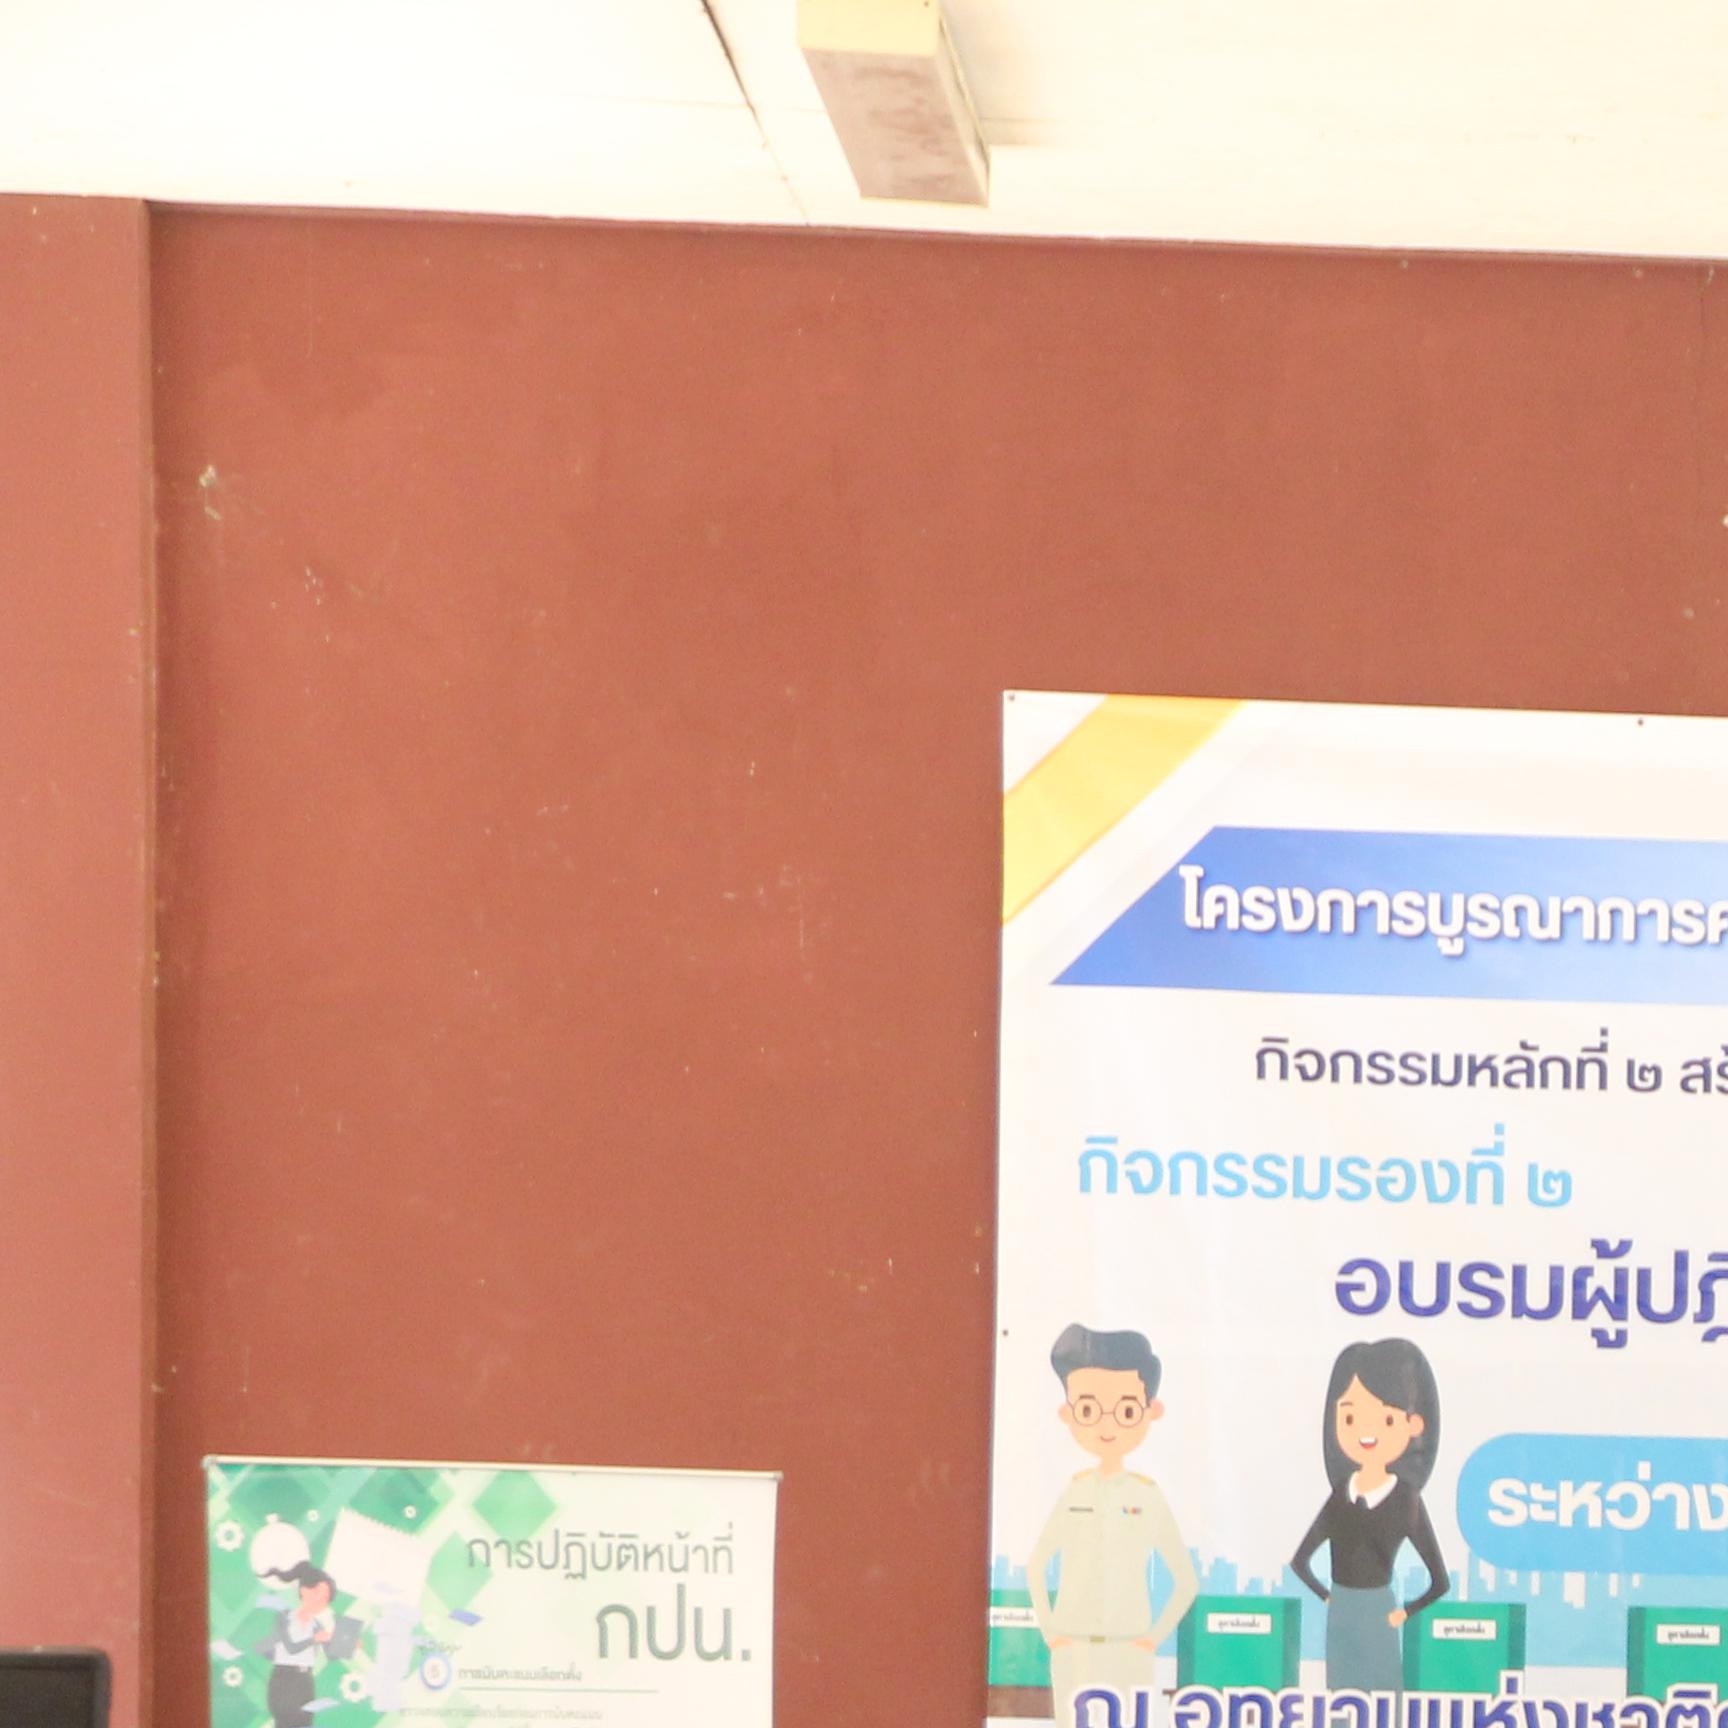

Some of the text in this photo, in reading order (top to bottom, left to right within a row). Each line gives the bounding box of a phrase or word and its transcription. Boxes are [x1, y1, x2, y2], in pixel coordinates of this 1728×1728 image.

[1254, 1029, 1609, 1092] กิจกรรมหลักที่
[1625, 1056, 1662, 1092] ๒
[1077, 1124, 1573, 1208] กิจกรรมรองที่ ๒
[466, 1521, 735, 1580] การปฏิบัติหน้าที่
[595, 1583, 753, 1662] กปน.
